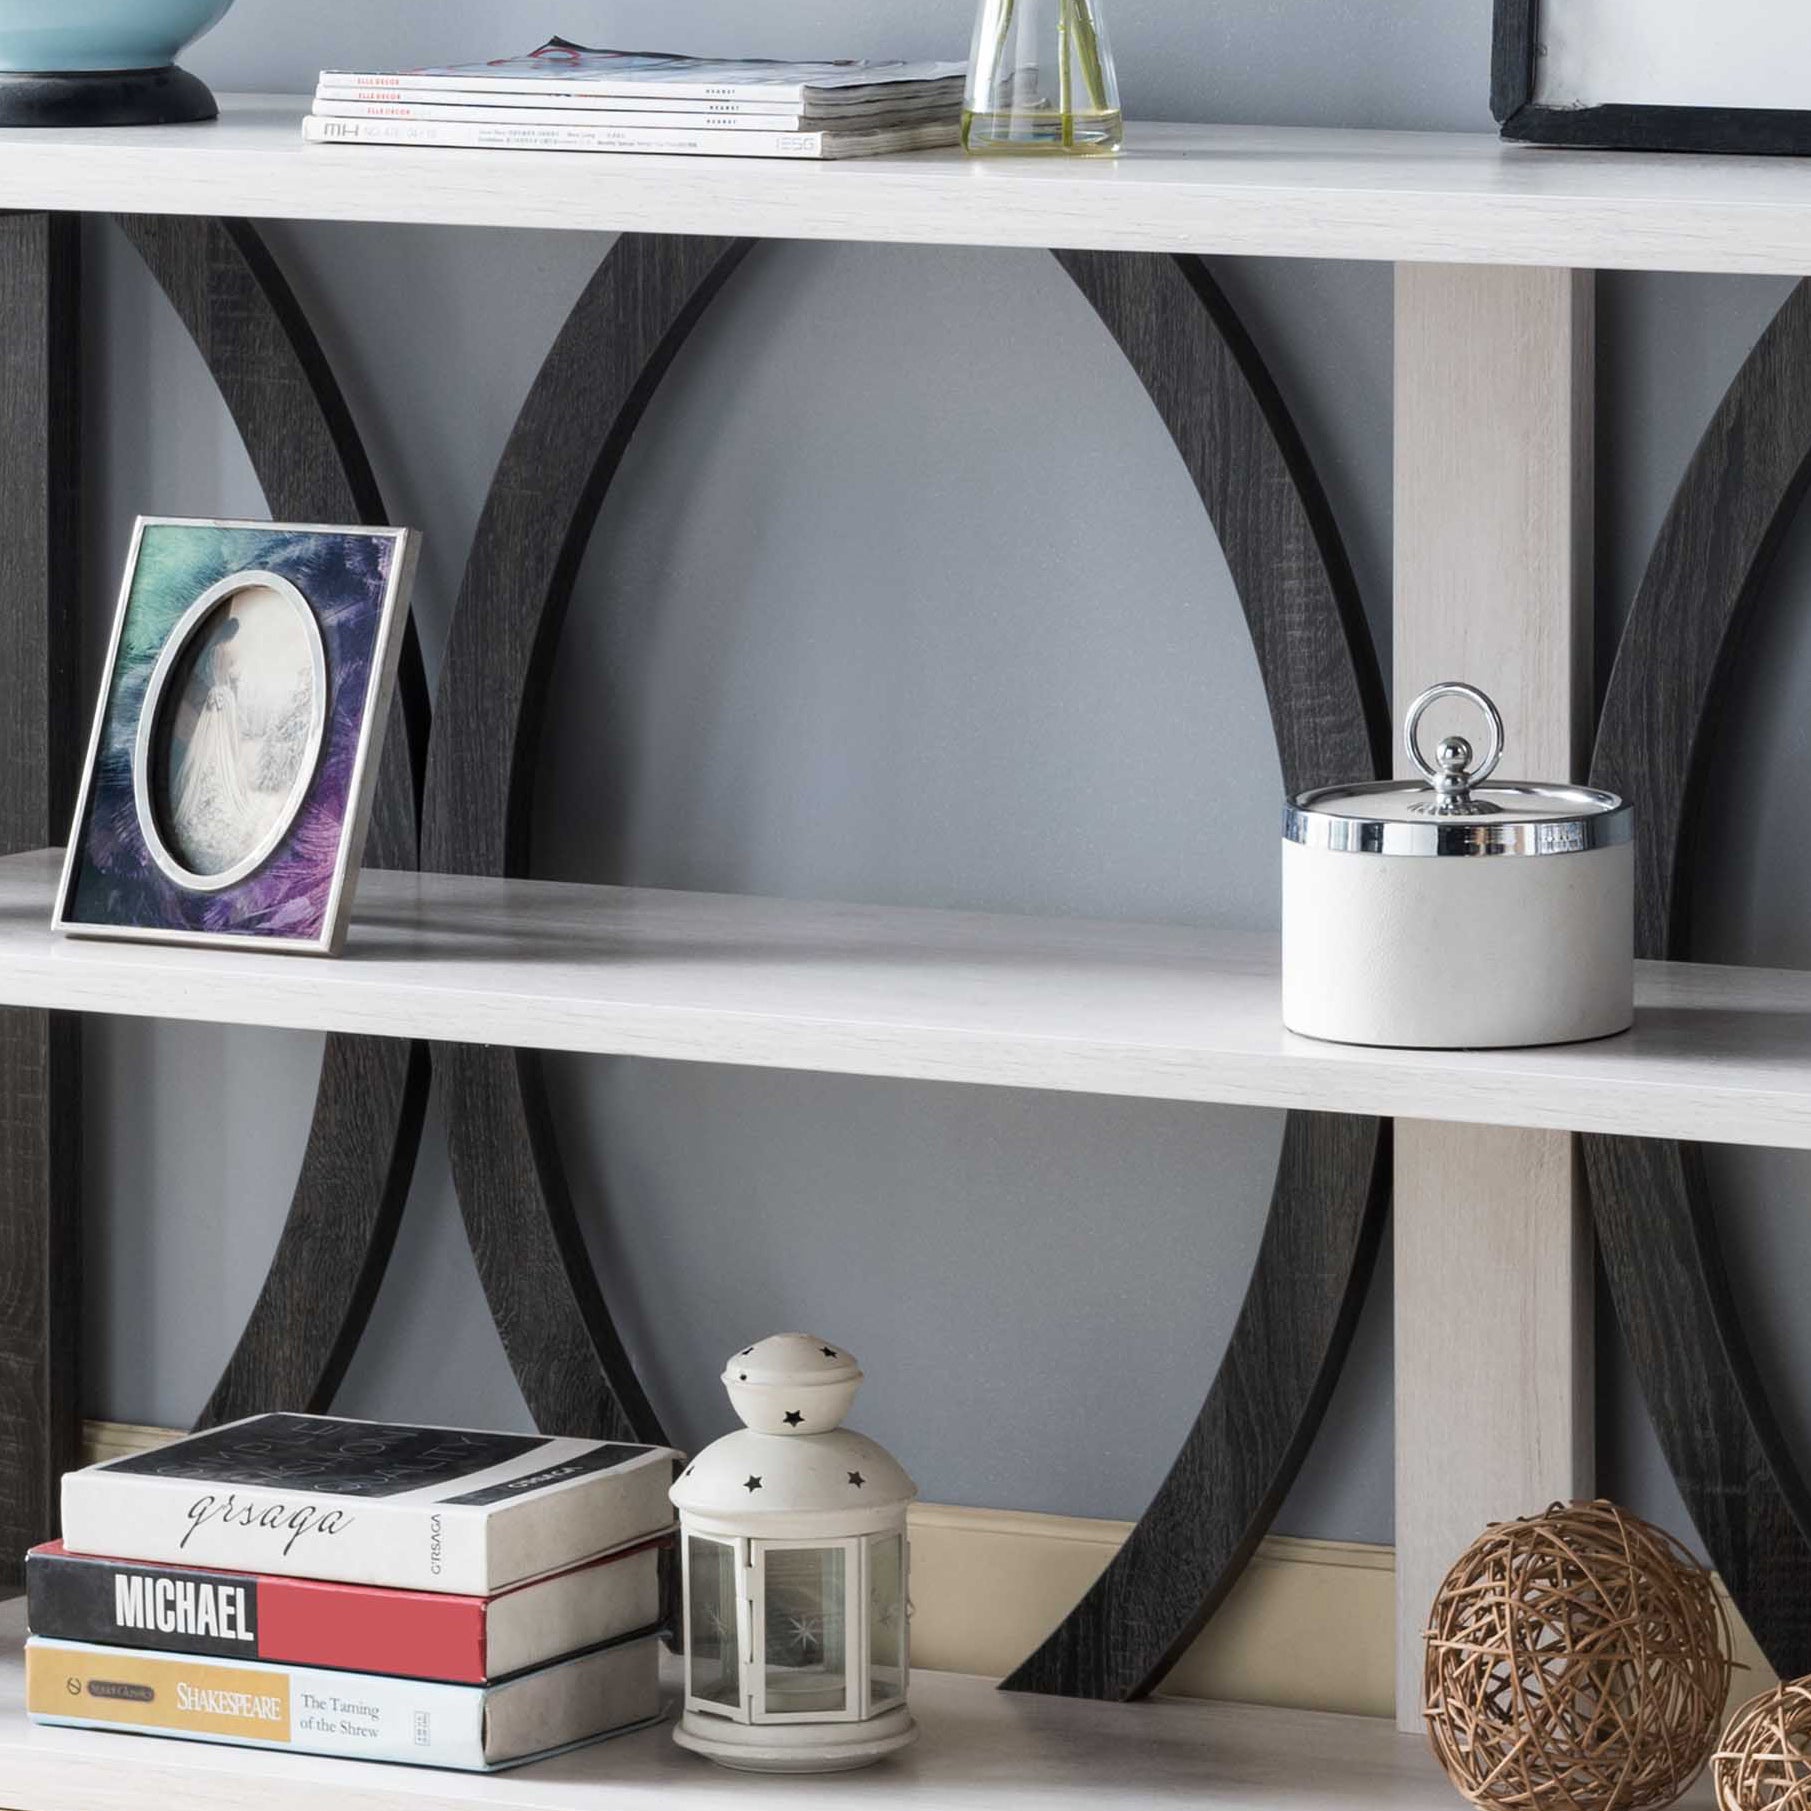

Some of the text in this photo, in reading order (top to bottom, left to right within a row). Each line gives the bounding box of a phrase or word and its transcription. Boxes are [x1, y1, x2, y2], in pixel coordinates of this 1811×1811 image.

[114, 1573, 255, 1642] MICHAEL
[175, 1682, 282, 1721] SHAKESPEARE
[301, 1694, 380, 1721] The Taming
[300, 1717, 380, 1739] of the Shrew
